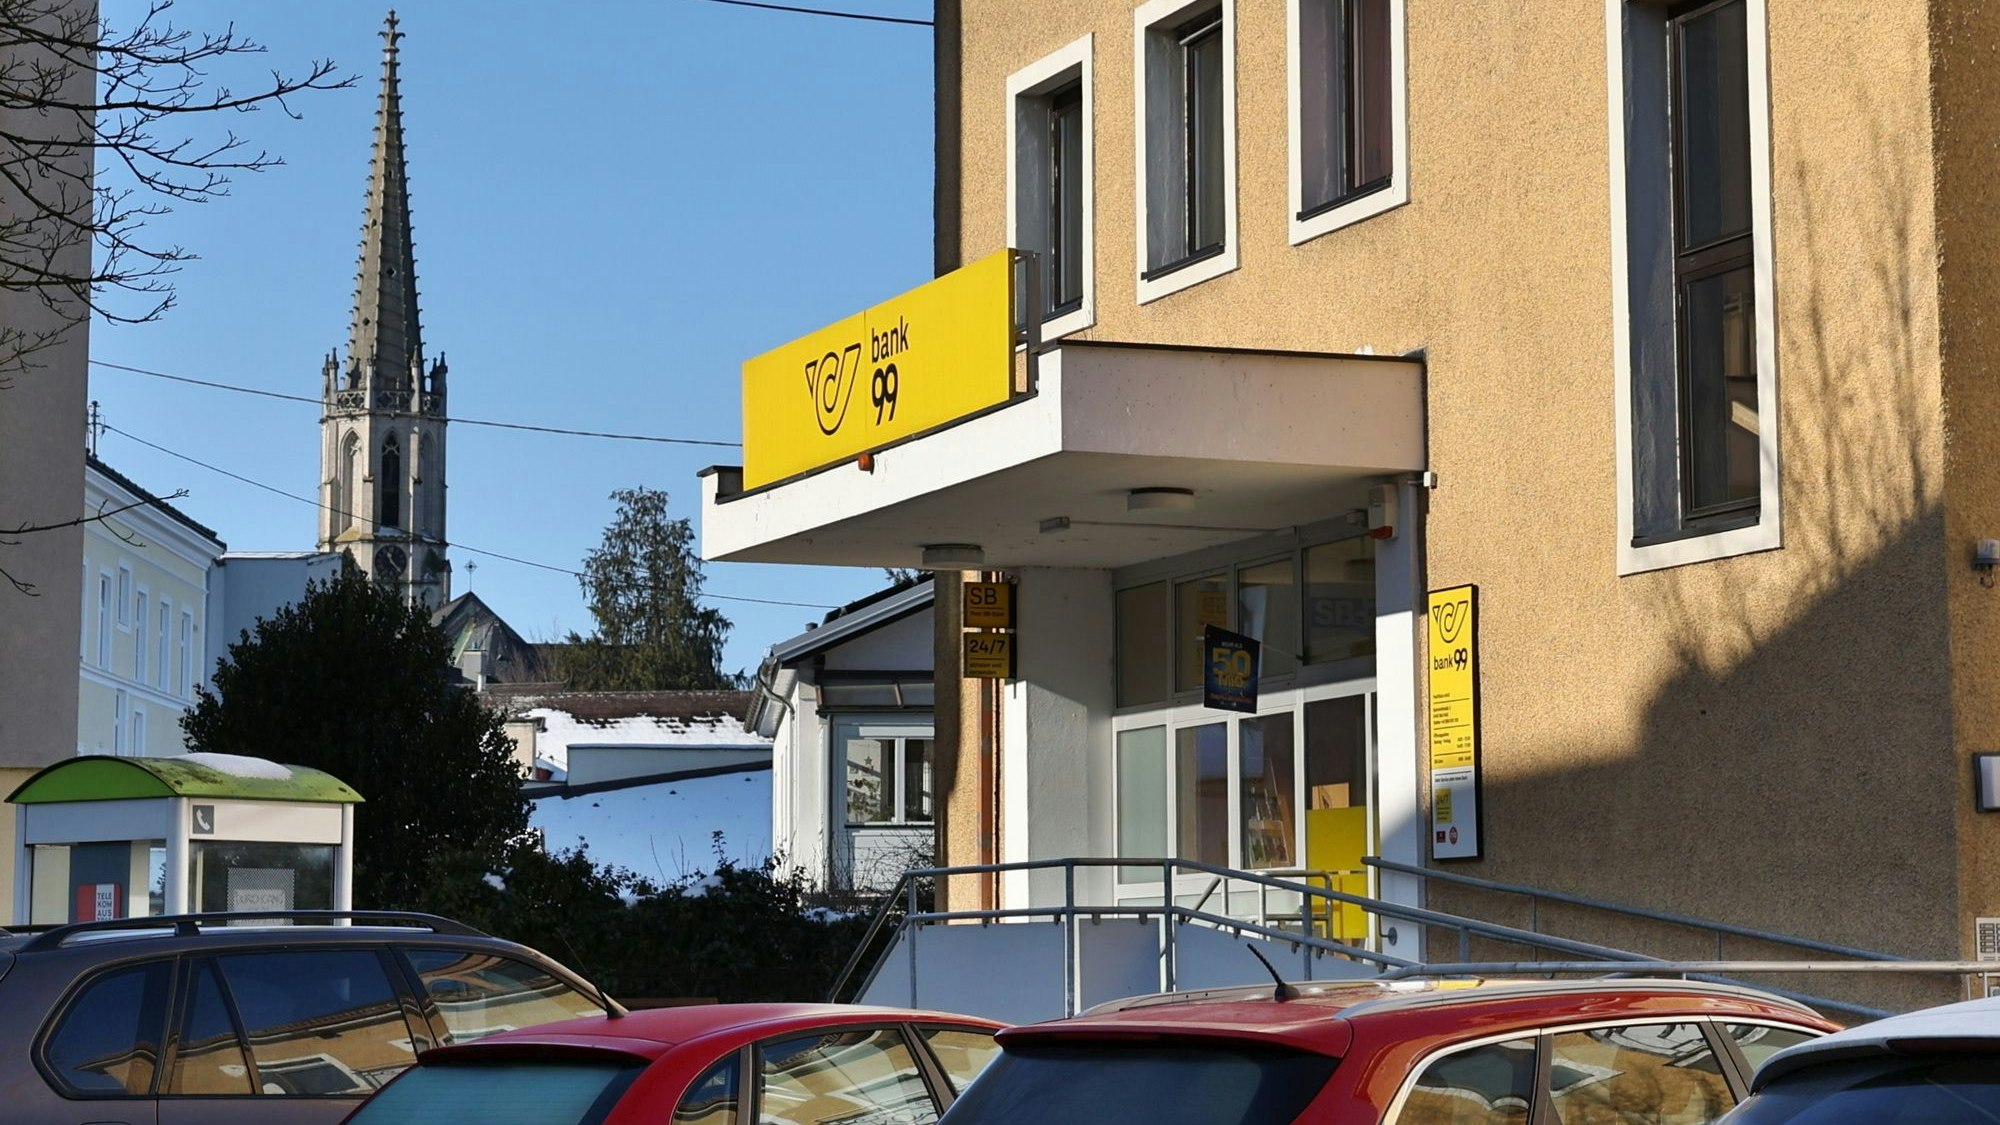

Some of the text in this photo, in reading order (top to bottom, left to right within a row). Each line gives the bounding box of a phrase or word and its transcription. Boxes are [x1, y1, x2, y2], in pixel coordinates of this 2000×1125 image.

[872, 315, 909, 364] bank
[872, 362, 899, 426] 99
[970, 587, 997, 605] SB
[969, 639, 1005, 654] 24/7
[1212, 647, 1252, 679] 50
[97, 892, 112, 900] TELE
[97, 900, 112, 908] KOM
[97, 909, 112, 917] AUS
